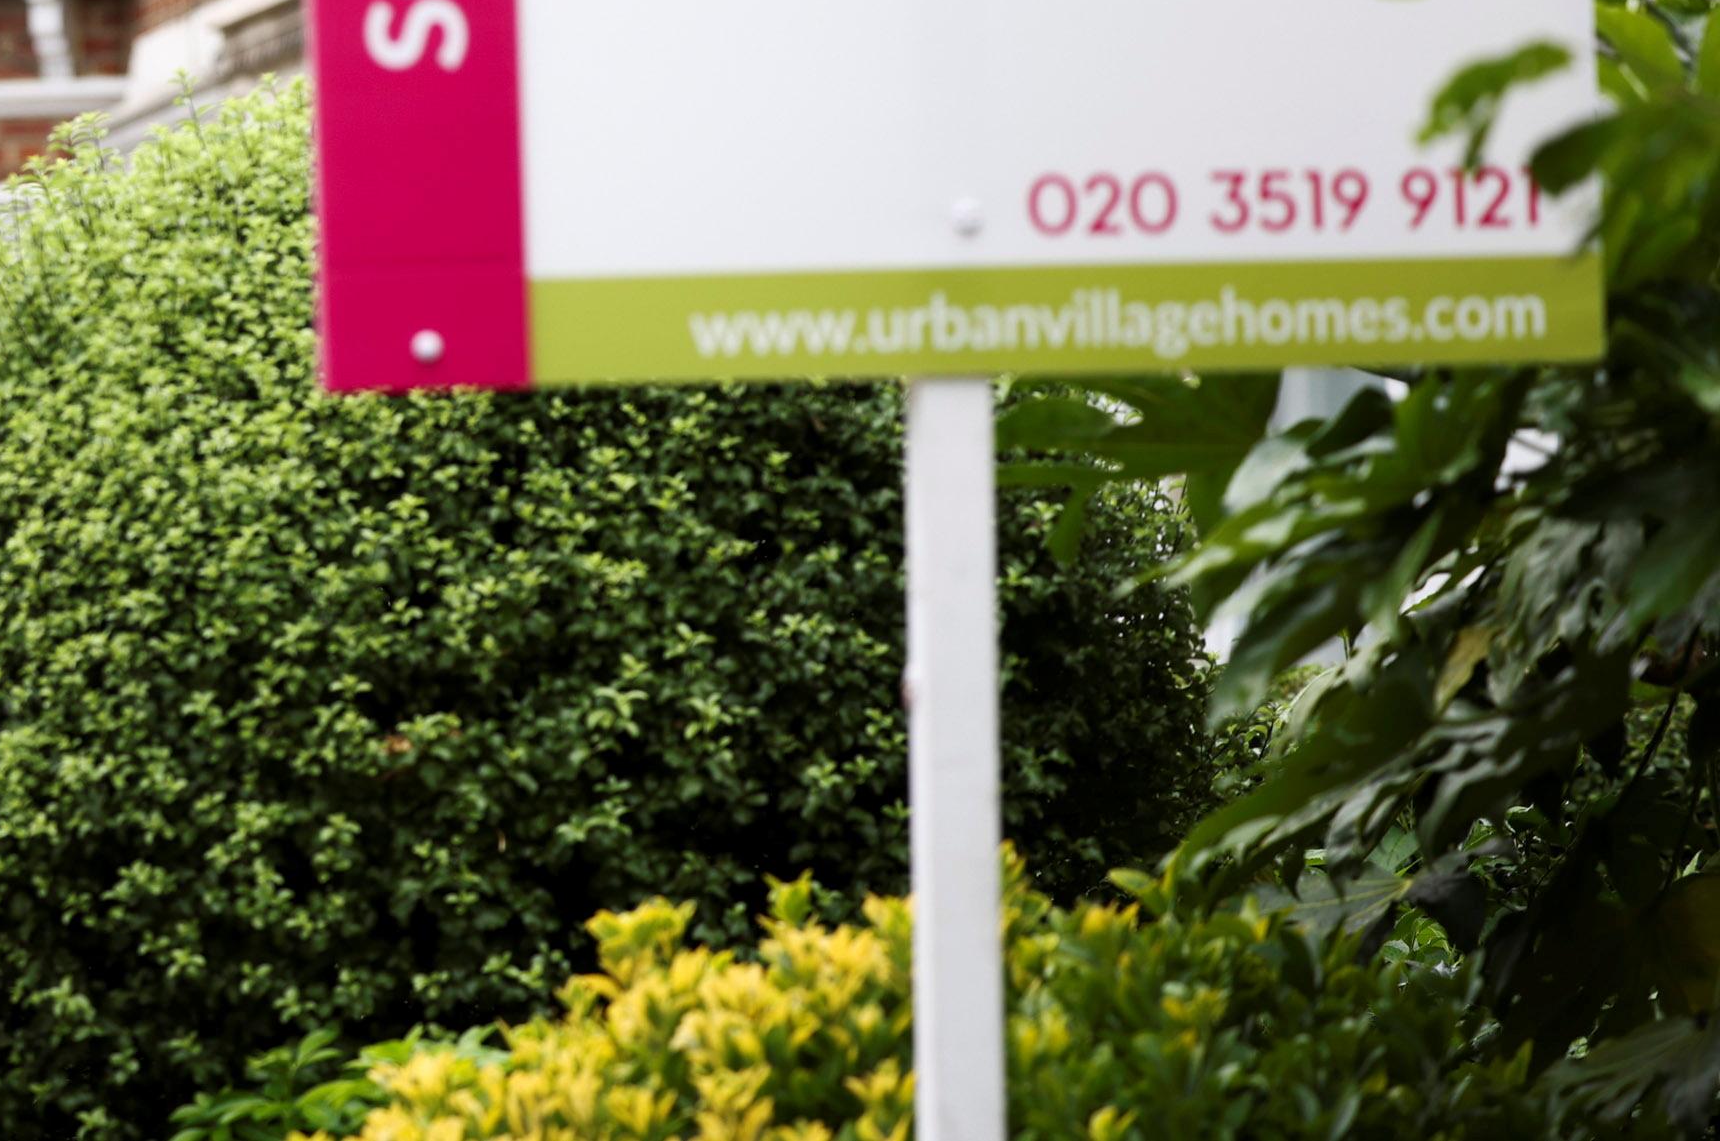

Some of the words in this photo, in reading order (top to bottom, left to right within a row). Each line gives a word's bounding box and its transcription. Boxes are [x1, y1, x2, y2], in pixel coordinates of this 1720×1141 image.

[1026, 171, 1179, 237] 020
[1208, 168, 1371, 234] 3519
[1399, 164, 1542, 230] 9121
[688, 286, 1548, 358] www.urbanvillagehomes.com
